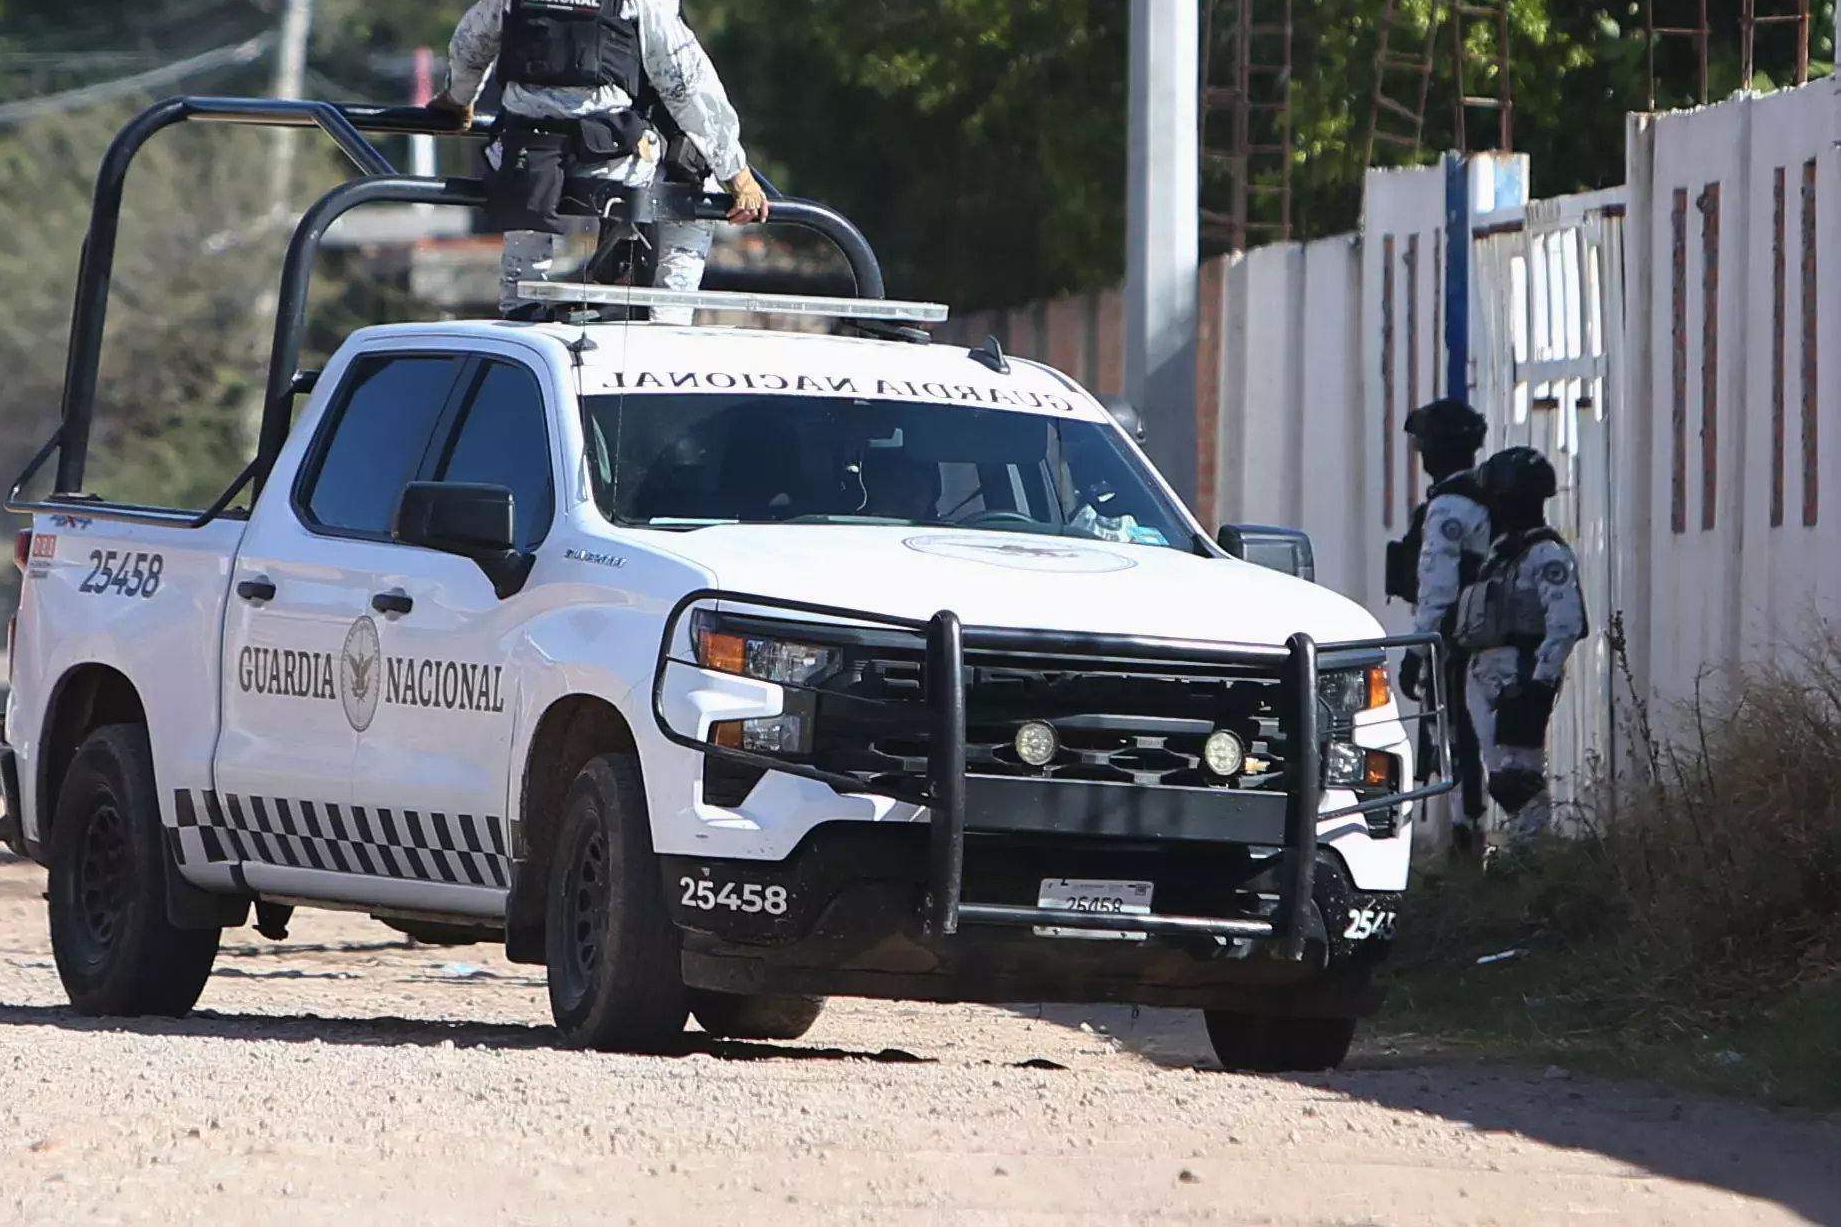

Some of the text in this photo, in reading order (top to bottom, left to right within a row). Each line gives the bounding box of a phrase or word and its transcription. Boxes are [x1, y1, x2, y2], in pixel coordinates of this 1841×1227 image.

[78, 548, 164, 599] 25458
[239, 645, 336, 700] GUARDIA
[385, 657, 504, 713] NACIONAL
[680, 876, 788, 915] 25458
